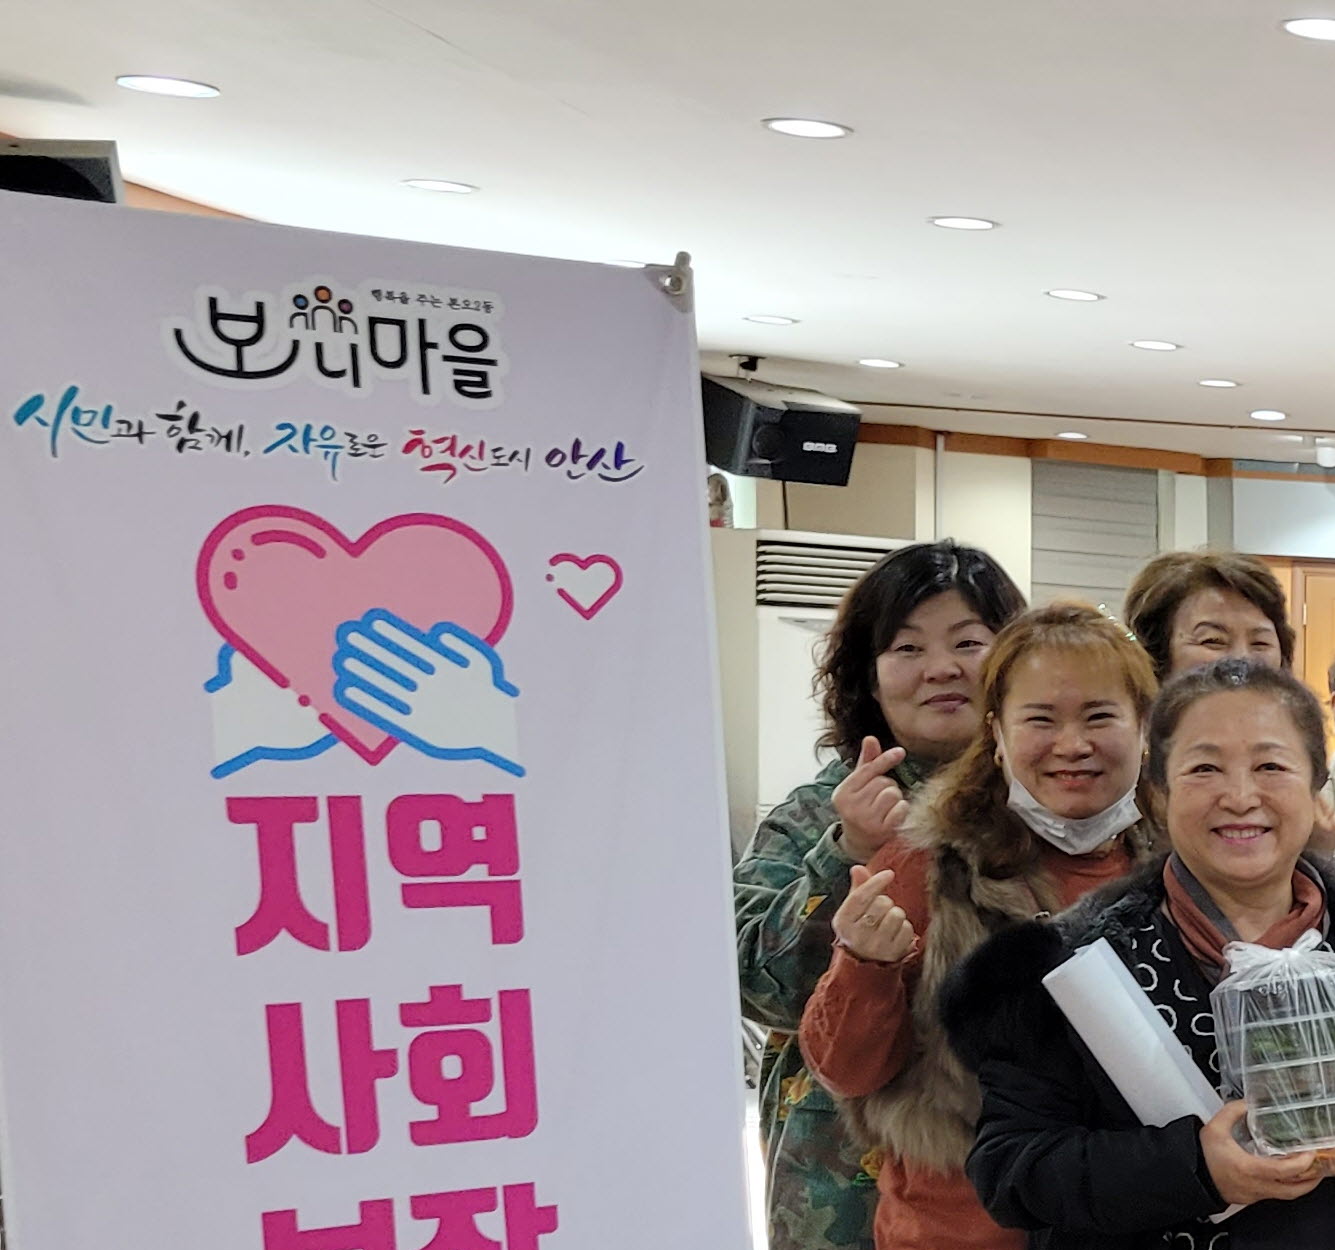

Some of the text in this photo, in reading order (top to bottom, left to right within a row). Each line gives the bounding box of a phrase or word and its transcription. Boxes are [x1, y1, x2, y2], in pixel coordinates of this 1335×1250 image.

[13, 385, 156, 458] 시민과
[263, 422, 388, 481] 자유로운
[401, 429, 531, 484] 혁신도시
[545, 438, 645, 482] 안산
[226, 793, 525, 957] 지역
[245, 984, 539, 1164] 사회
